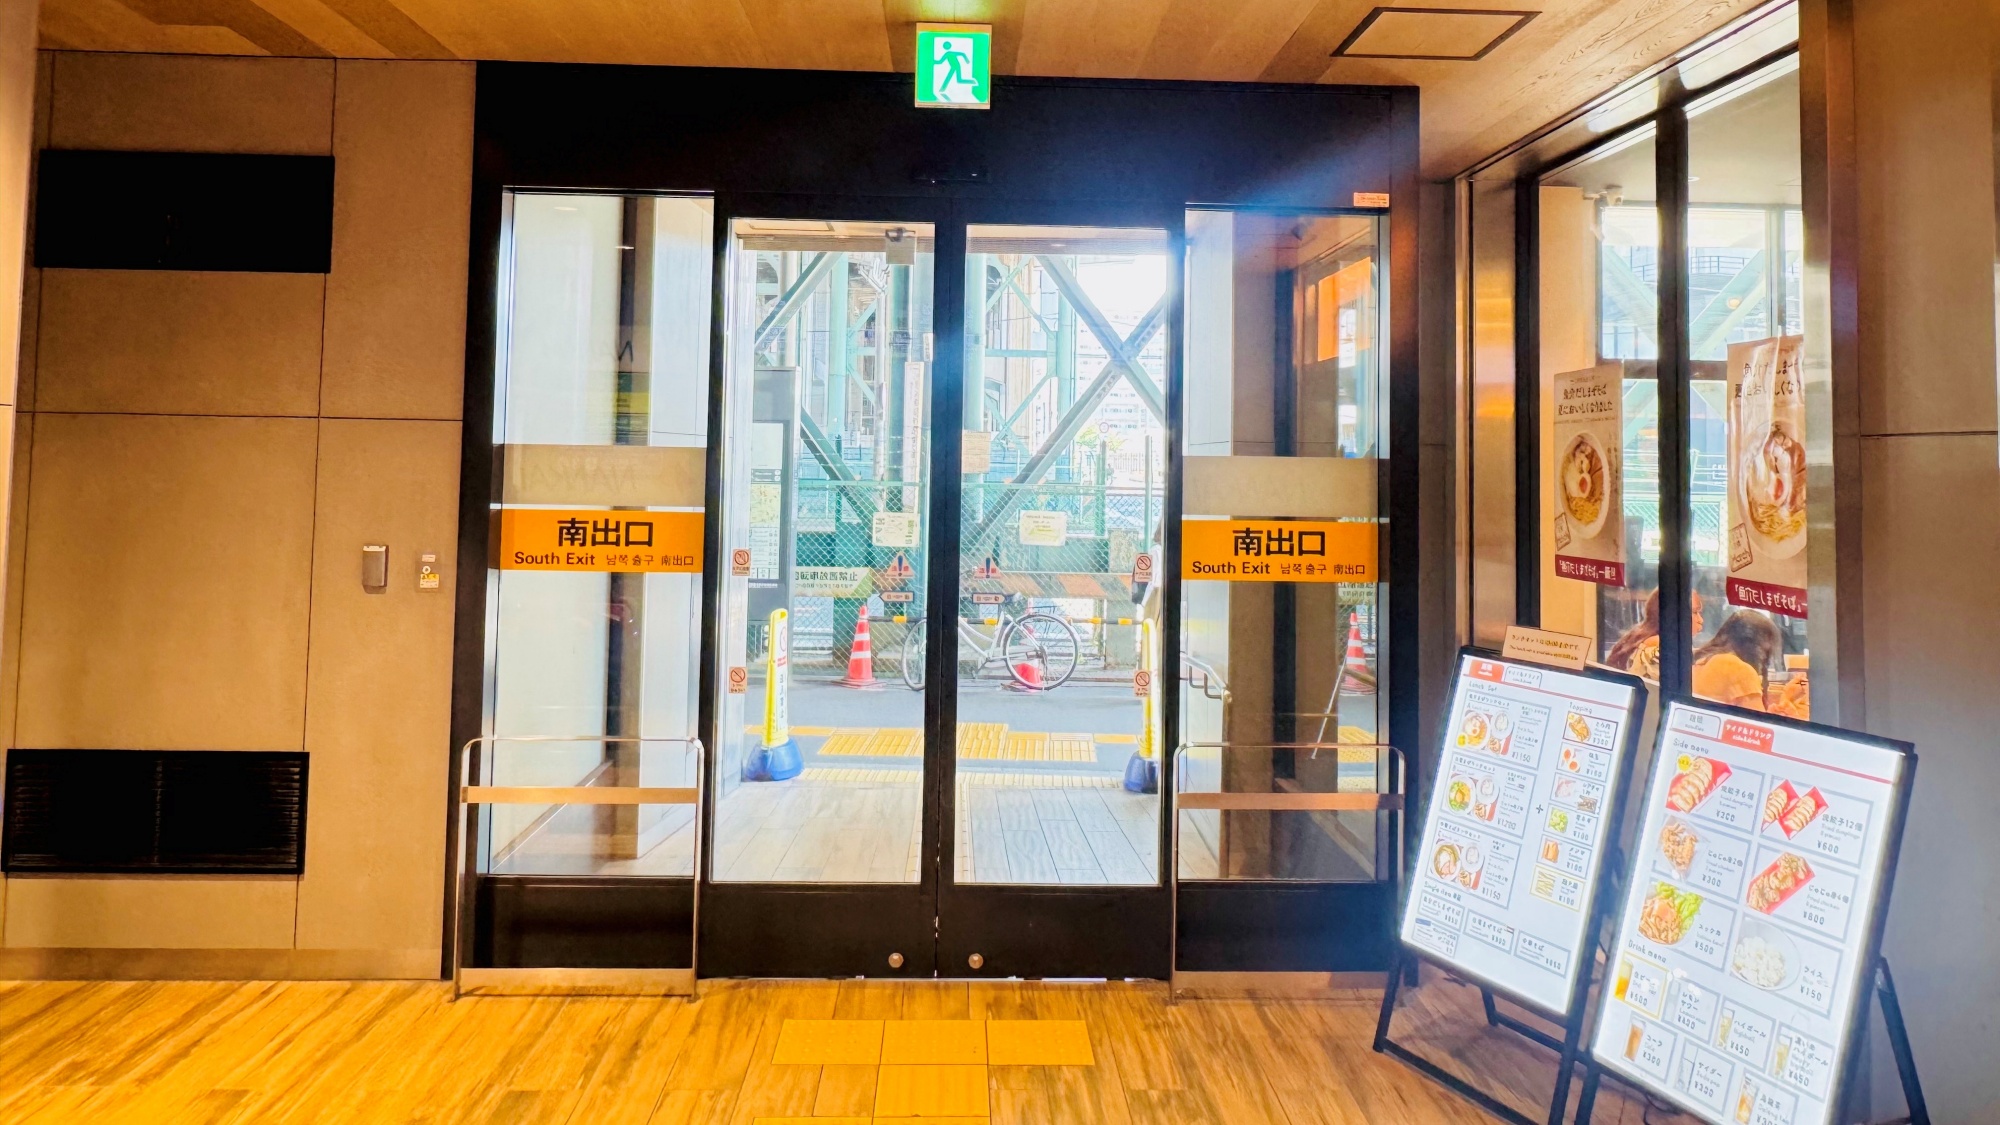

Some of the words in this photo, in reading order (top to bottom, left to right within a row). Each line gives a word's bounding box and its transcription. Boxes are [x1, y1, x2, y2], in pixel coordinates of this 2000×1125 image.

[557, 518, 654, 547] 南出口
[1232, 527, 1326, 557] 南出口
[514, 551, 560, 565] South
[567, 552, 595, 566] Exit
[661, 555, 694, 567] 南出口
[1192, 561, 1236, 575] South
[1242, 562, 1271, 575] Exit
[1333, 564, 1366, 576] 南出口
[1673, 737, 1689, 749] Side
[1817, 839, 1839, 854] ¥600
[1803, 910, 1825, 926] ¥800
[1628, 939, 1646, 955] Drink
[1694, 940, 1714, 955] ¥500
[1629, 990, 1648, 1007] ¥500
[1800, 984, 1822, 1002] ¥150
[1734, 1020, 1767, 1038] ハイボール
[1730, 1039, 1750, 1057] ¥450
[1788, 1068, 1810, 1087] ¥450
